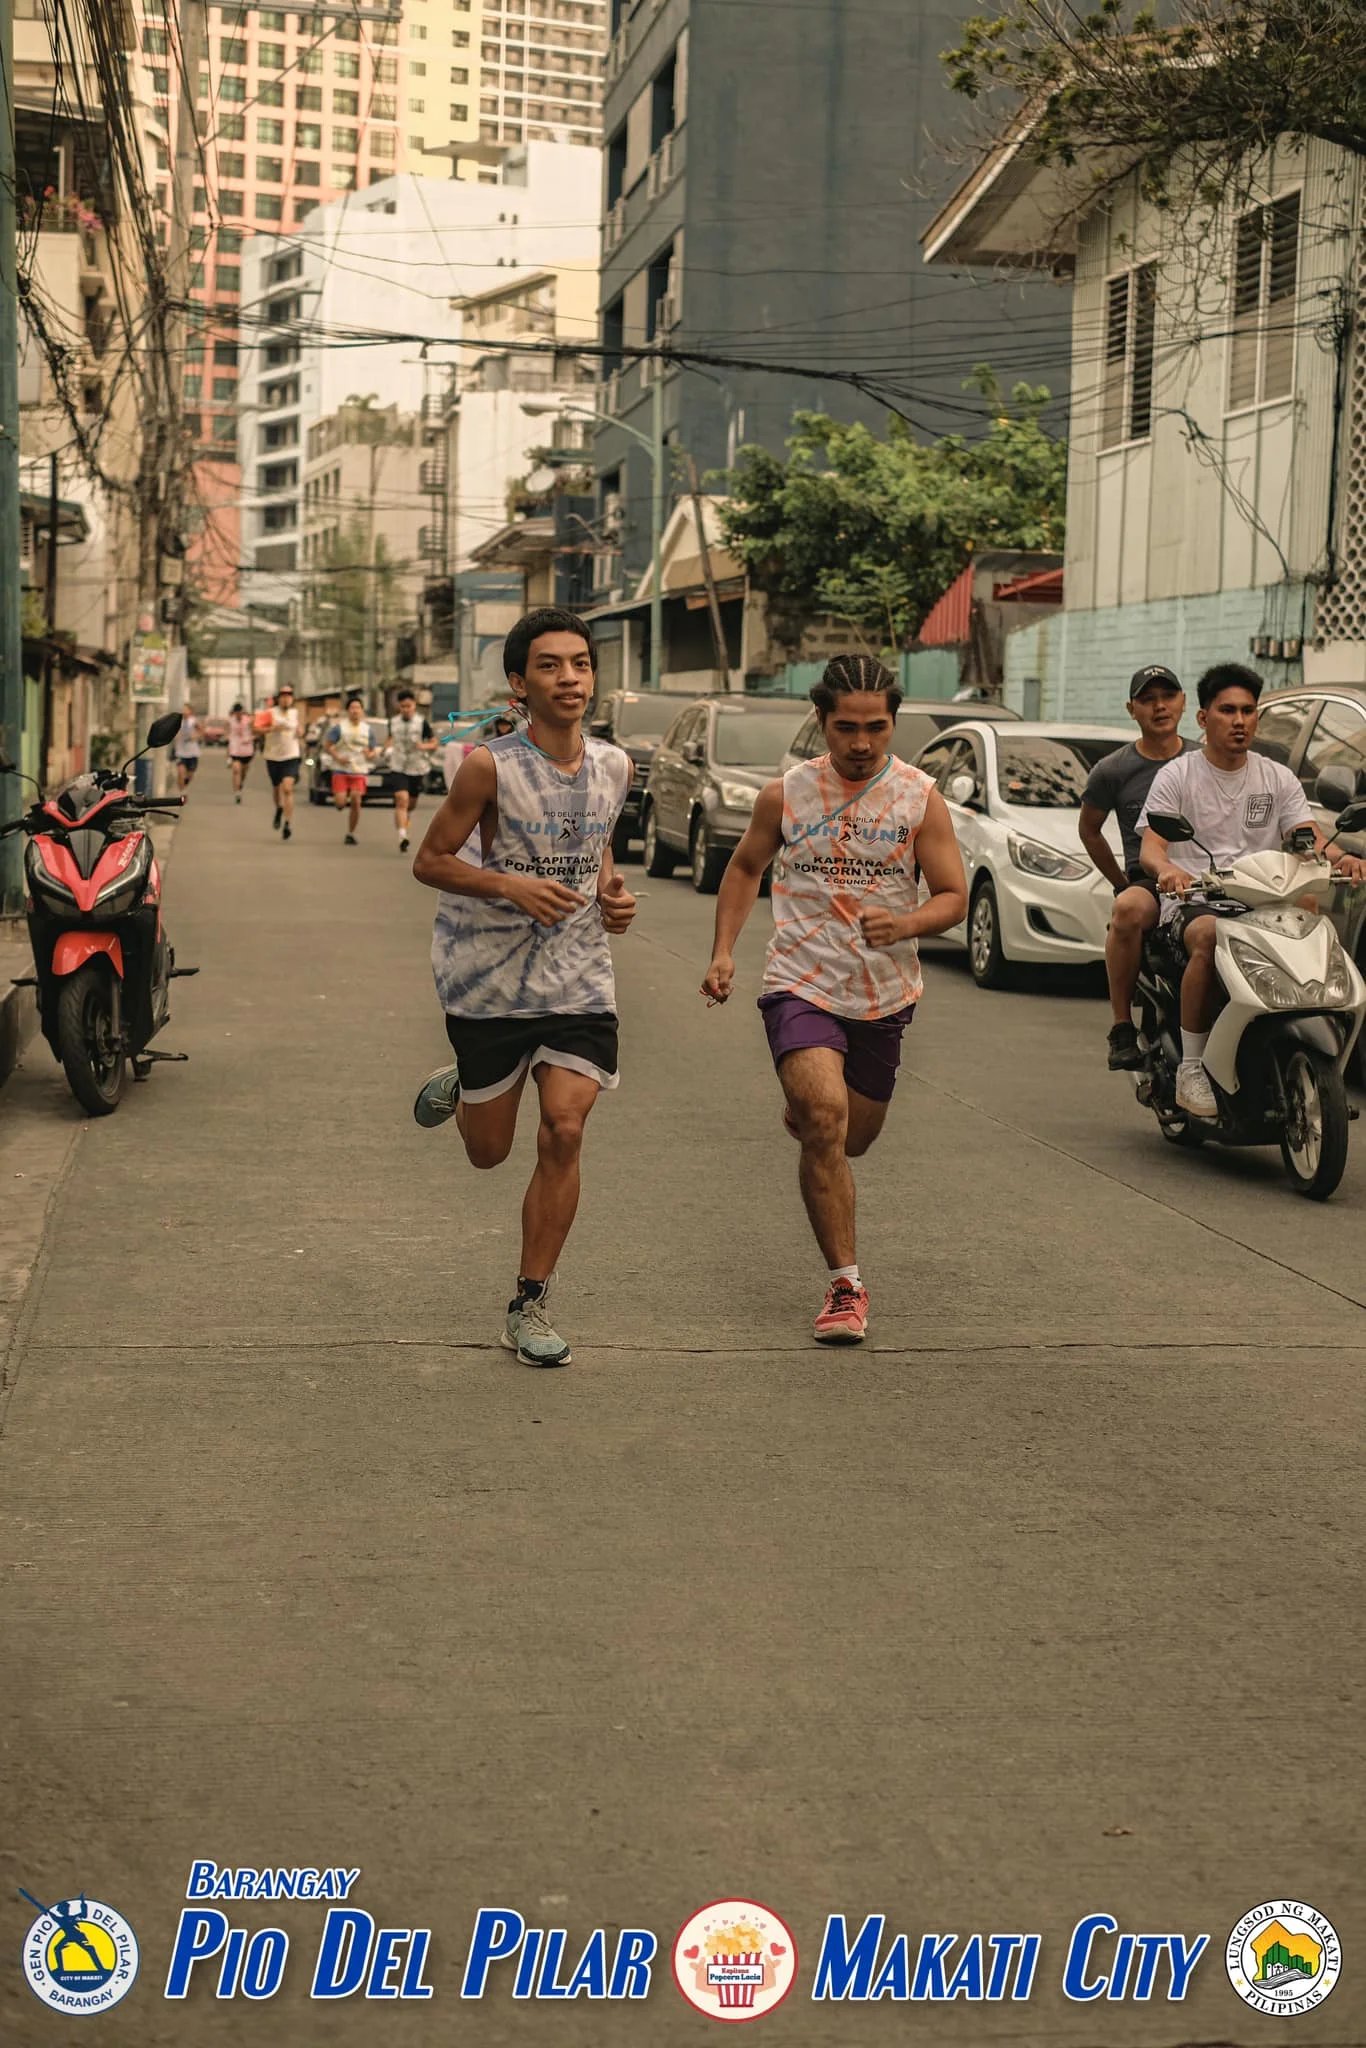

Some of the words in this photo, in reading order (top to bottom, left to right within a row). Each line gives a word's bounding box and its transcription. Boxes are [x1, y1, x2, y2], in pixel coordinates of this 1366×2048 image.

[855, 816, 880, 824] PILAR
[792, 823, 839, 836] FUN
[531, 856, 594, 865] KAPITANA
[813, 856, 884, 867] KAPITANA
[504, 859, 576, 876] POPCORN
[579, 864, 599, 875] LAC
[794, 862, 861, 876] POPCORN
[866, 867, 905, 877] LACIA
